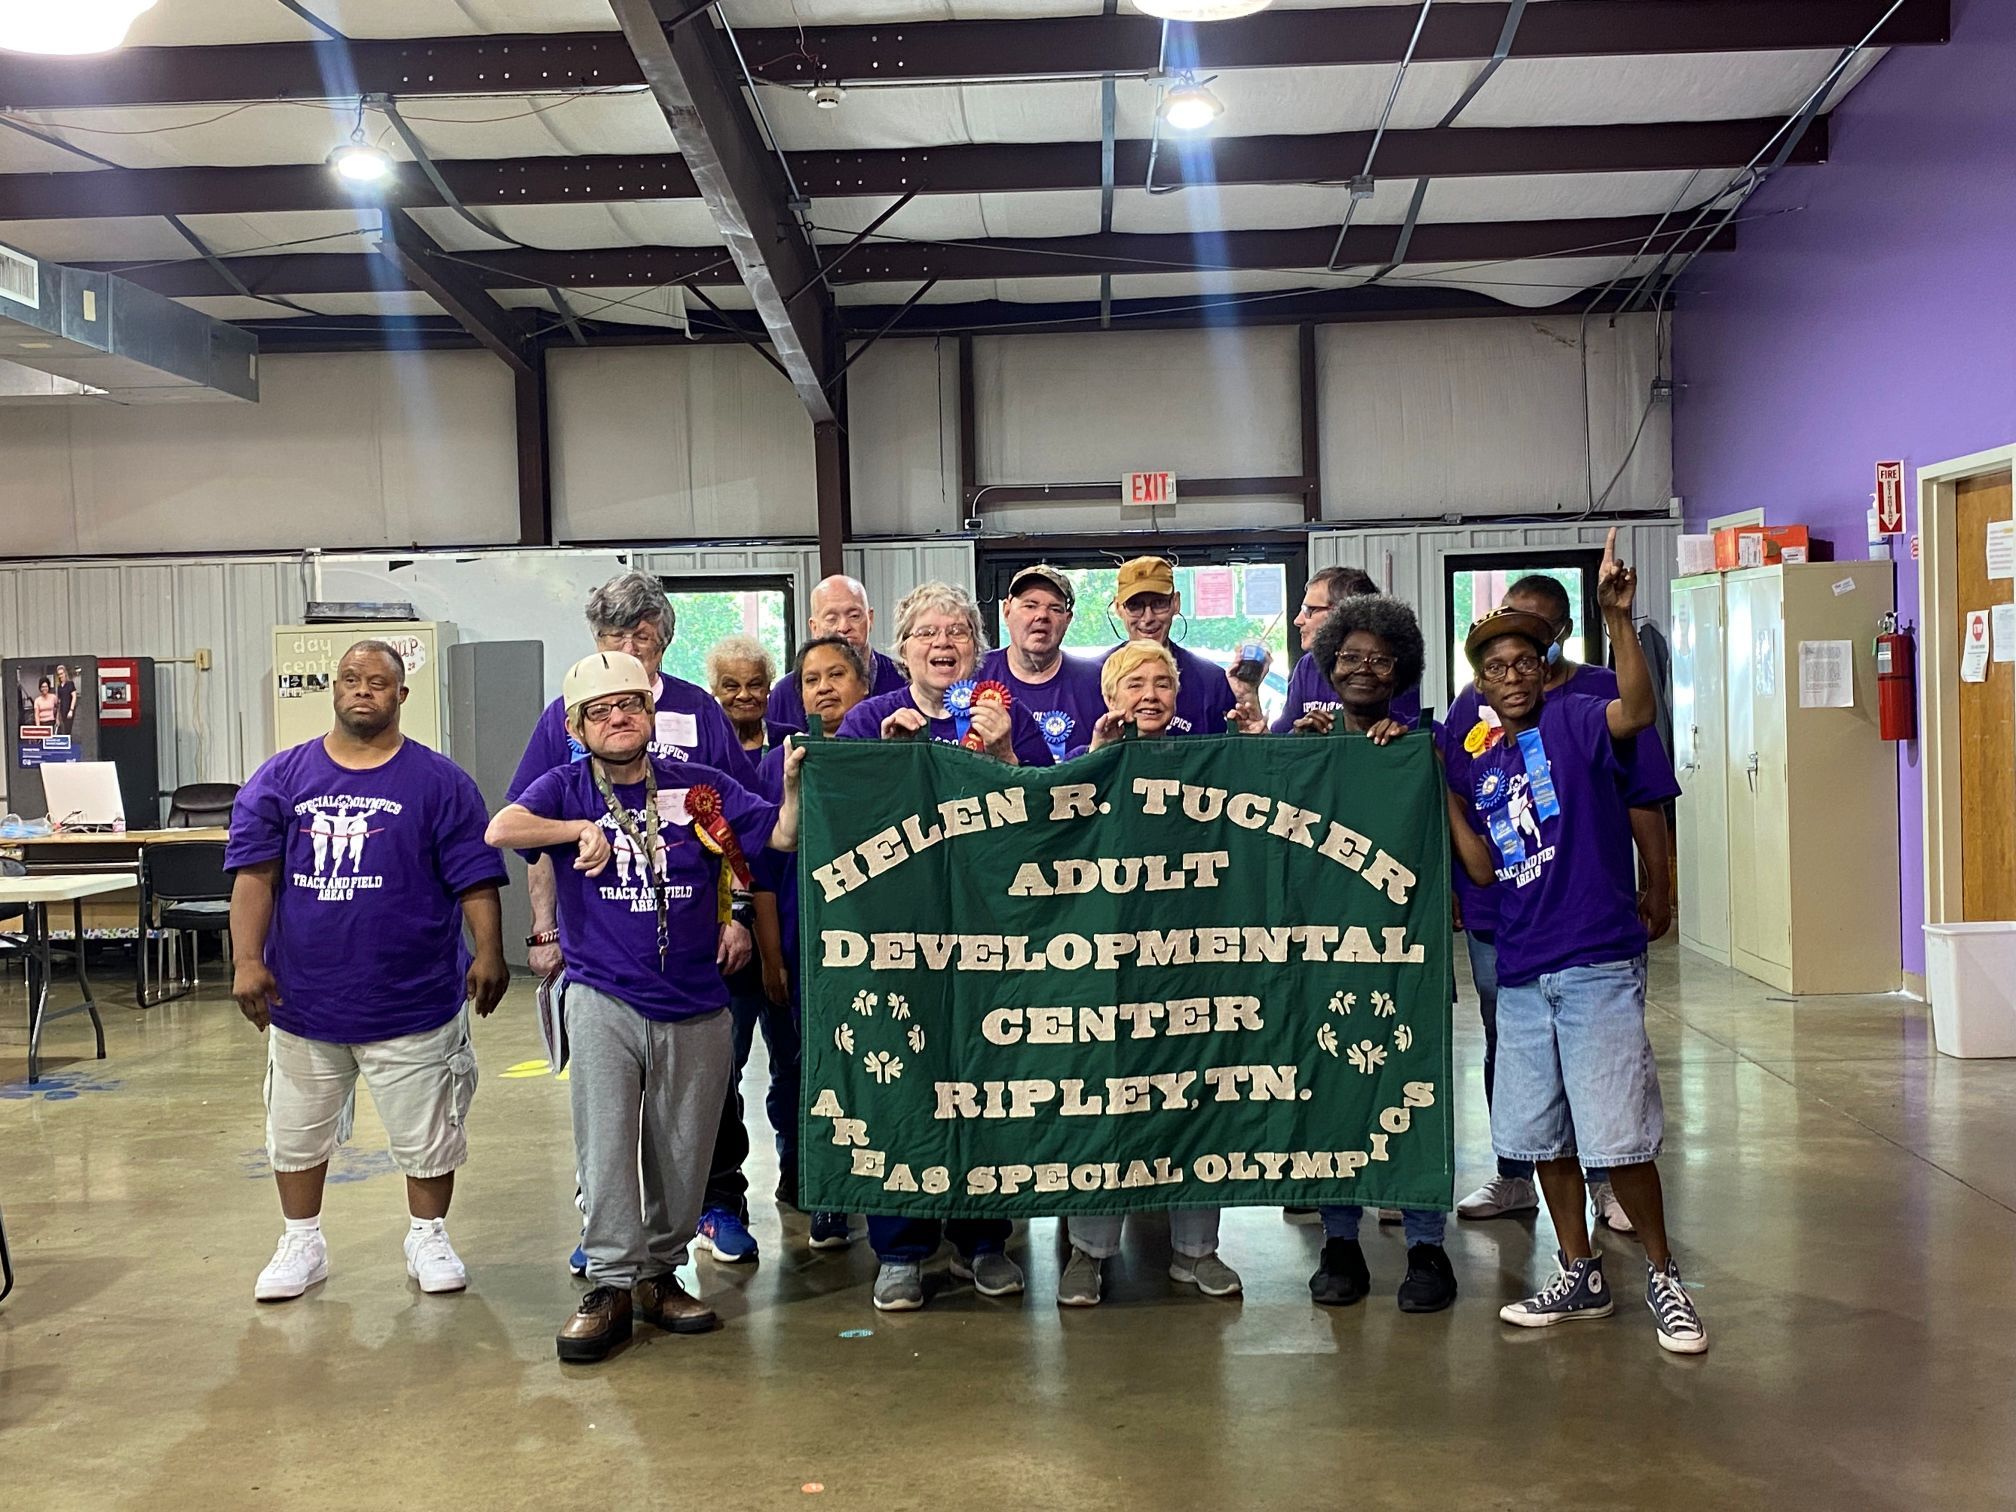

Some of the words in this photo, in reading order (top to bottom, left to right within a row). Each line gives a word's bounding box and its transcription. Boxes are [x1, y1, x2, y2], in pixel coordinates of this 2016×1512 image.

[1880, 470, 1897, 479] FIRE
[1132, 473, 1168, 502] EXIT
[293, 635, 333, 657] day
[283, 655, 339, 674] cente
[646, 741, 689, 762] LYMPICS
[294, 796, 337, 816] SPECIAL
[351, 797, 403, 816] OLYMPICS
[812, 786, 1028, 903] HELEN
[1049, 782, 1111, 821] R.
[1133, 777, 1417, 905] TUCKER
[293, 873, 326, 889] TRACK
[327, 877, 351, 889] AND
[351, 876, 383, 889] FIELD
[1008, 851, 1230, 896] ADULT
[317, 888, 344, 901] AREA
[345, 888, 354, 901] 8
[599, 886, 638, 900] TRACK
[640, 886, 660, 900] AN
[664, 886, 693, 899] FIELD
[821, 925, 1425, 971] DEVELOPMENTAL
[982, 996, 1264, 1045] CENTER
[966, 1157, 1184, 1195] SPECIAL
[1193, 1081, 1435, 1184] OLYMPICS
